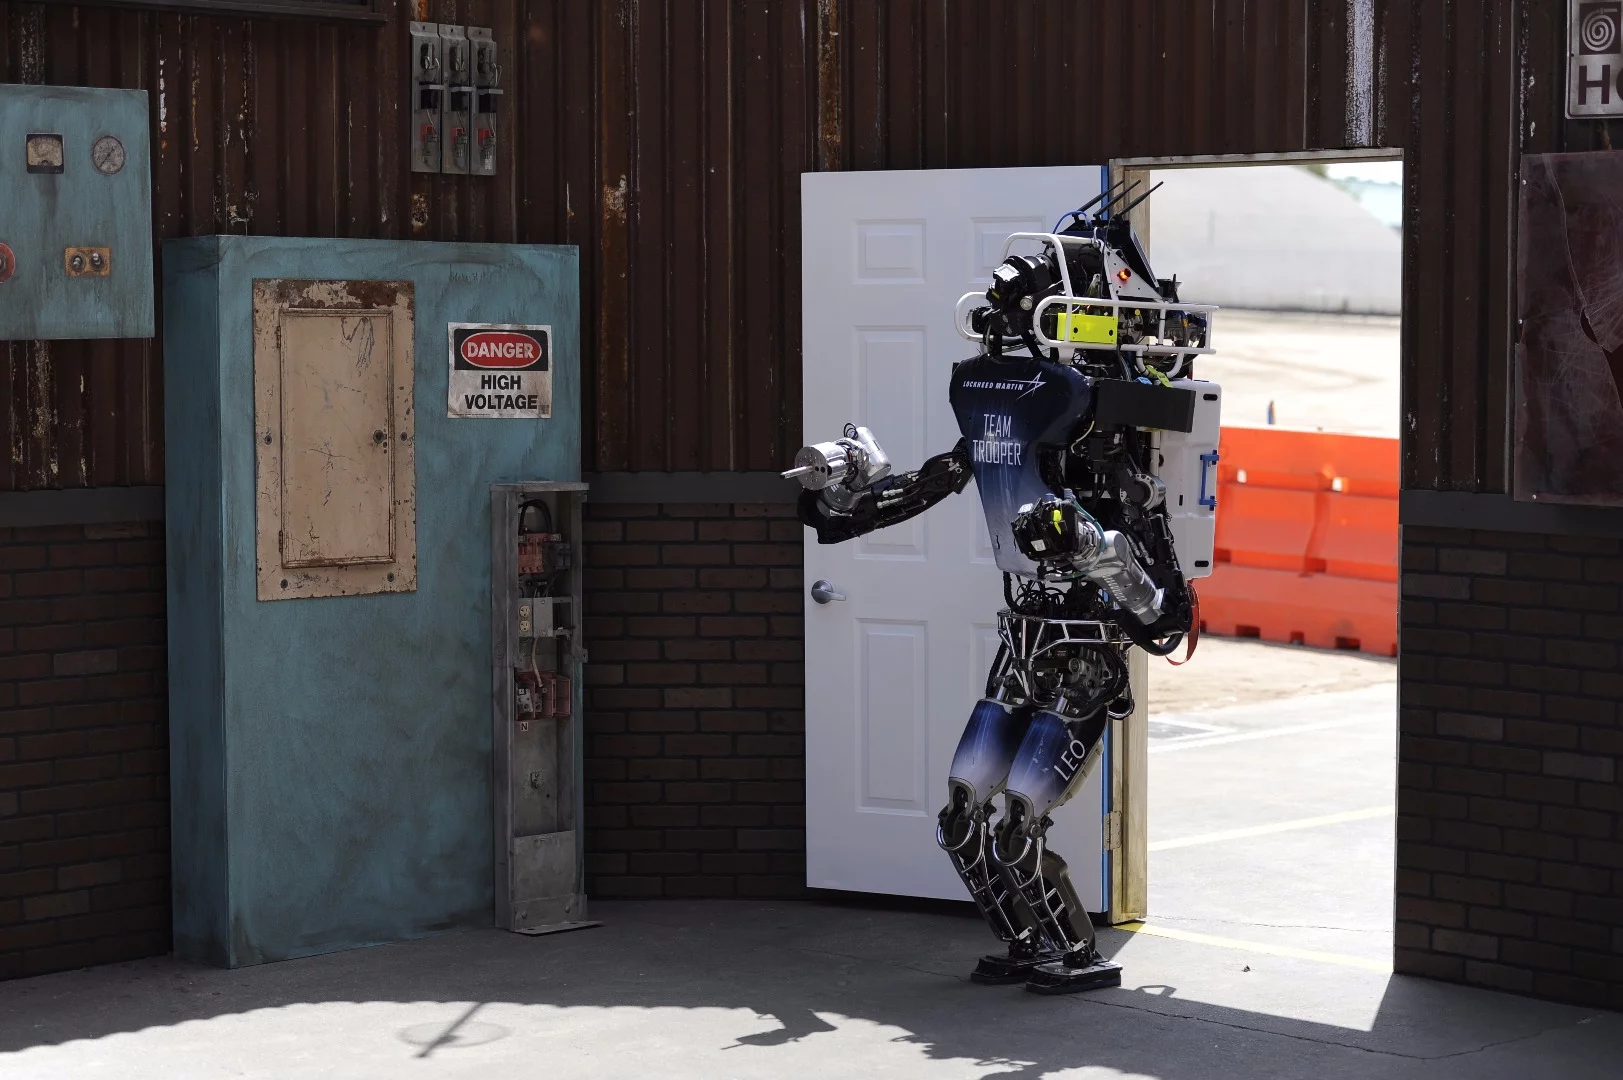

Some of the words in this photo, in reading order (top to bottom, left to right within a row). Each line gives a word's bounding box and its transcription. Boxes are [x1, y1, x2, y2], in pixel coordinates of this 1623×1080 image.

[1578, 64, 1623, 106] H
[467, 342, 535, 359] DANGER
[480, 374, 522, 390] HIGH
[962, 380, 994, 389] LOCKHEED
[995, 382, 1024, 391] MARTIN
[464, 394, 538, 410] VOLTAGE
[983, 413, 1012, 438] TEAM
[972, 439, 1022, 466] TROOPER
[521, 722, 528, 731] N
[1053, 739, 1086, 782] LEO
